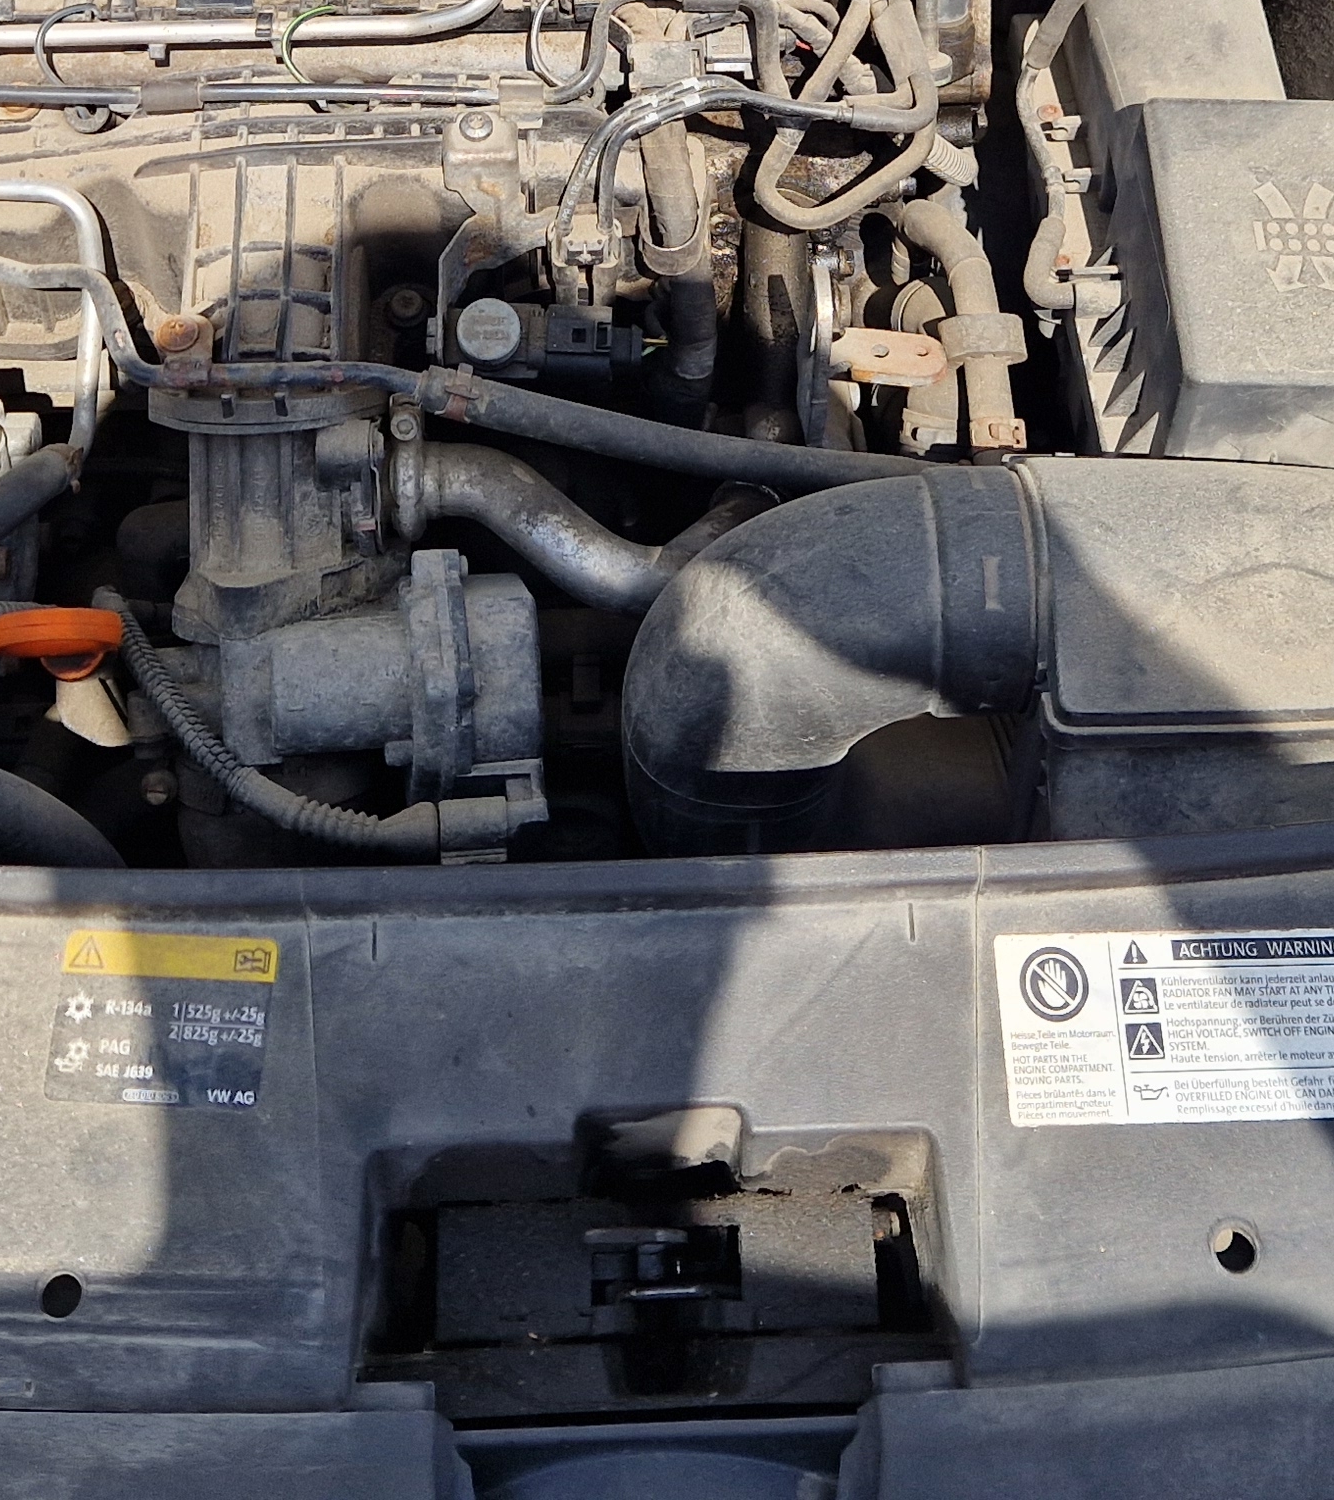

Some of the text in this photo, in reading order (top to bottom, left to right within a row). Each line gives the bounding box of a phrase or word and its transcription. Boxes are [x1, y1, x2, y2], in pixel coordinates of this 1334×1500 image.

[1179, 941, 1258, 958] ACHTUNG
[1161, 975, 1238, 986] Kühlerventilator
[1240, 974, 1263, 985] kann
[1264, 973, 1307, 987] jederzeit
[1162, 987, 1211, 998] RADIATOR
[1213, 986, 1233, 997] FAN
[1234, 986, 1256, 997] MAY
[1259, 985, 1286, 996] START
[1289, 985, 1301, 995] AT
[1303, 984, 1323, 995] ANY
[1164, 1001, 1175, 1011] Le
[1176, 999, 1229, 1010] ventilateur
[1230, 998, 1243, 1009] de
[1244, 997, 1288, 1008] radiateur
[1290, 997, 1312, 1010] peut
[1314, 998, 1325, 1007] se
[105, 999, 153, 1017] R-134a
[187, 1004, 222, 1024] 525g
[1166, 1017, 1242, 1030] Hochspannung,
[1242, 1017, 1257, 1026] vor
[1259, 1014, 1303, 1025] Berühren
[1305, 1014, 1320, 1024] der
[183, 1026, 219, 1046] 825g
[1057, 1030, 1067, 1038] im
[1168, 1029, 1193, 1039] HIGH
[1195, 1028, 1242, 1039] VOLTAGE,
[1244, 1026, 1281, 1037] SWITCH
[1283, 1026, 1301, 1036] OFF
[98, 1038, 131, 1055] PAG
[1011, 1041, 1048, 1052] Bewegte
[1169, 1041, 1210, 1051] SYSTEM.
[1012, 1054, 1088, 1064] HOT PARTS IN THE
[1170, 1054, 1200, 1063] Haute
[1204, 1053, 1242, 1063] tension,
[1245, 1052, 1277, 1062] arrêter
[1279, 1050, 1288, 1060] le
[1290, 1051, 1326, 1060] moteur
[95, 1063, 154, 1079] SAE J639
[1013, 1063, 1116, 1074] ENGINE COMPARTMENT.
[1014, 1075, 1084, 1085] MOVING PARTS.
[1174, 1080, 1189, 1090] Bei
[1191, 1078, 1250, 1091] Überfüllung
[1251, 1077, 1288, 1087] besteht
[1290, 1076, 1324, 1087] Gefahr
[206, 1088, 256, 1105] VW AG
[1016, 1090, 1042, 1099] Pièces
[1086, 1088, 1107, 1097] dans
[1108, 1088, 1116, 1097] le
[1175, 1091, 1233, 1102] OVERFILLED
[1235, 1090, 1273, 1101] ENGINE
[1275, 1090, 1291, 1100] OIL
[1295, 1089, 1316, 1099] CAN
[1017, 1100, 1078, 1111] compartiment
[1177, 1104, 1238, 1117] Remplissage
[1239, 1103, 1277, 1113] excessif
[1280, 1101, 1313, 1111] d'huile
[1018, 1110, 1044, 1119] Pièces
[1059, 1109, 1113, 1119] mouvement.
